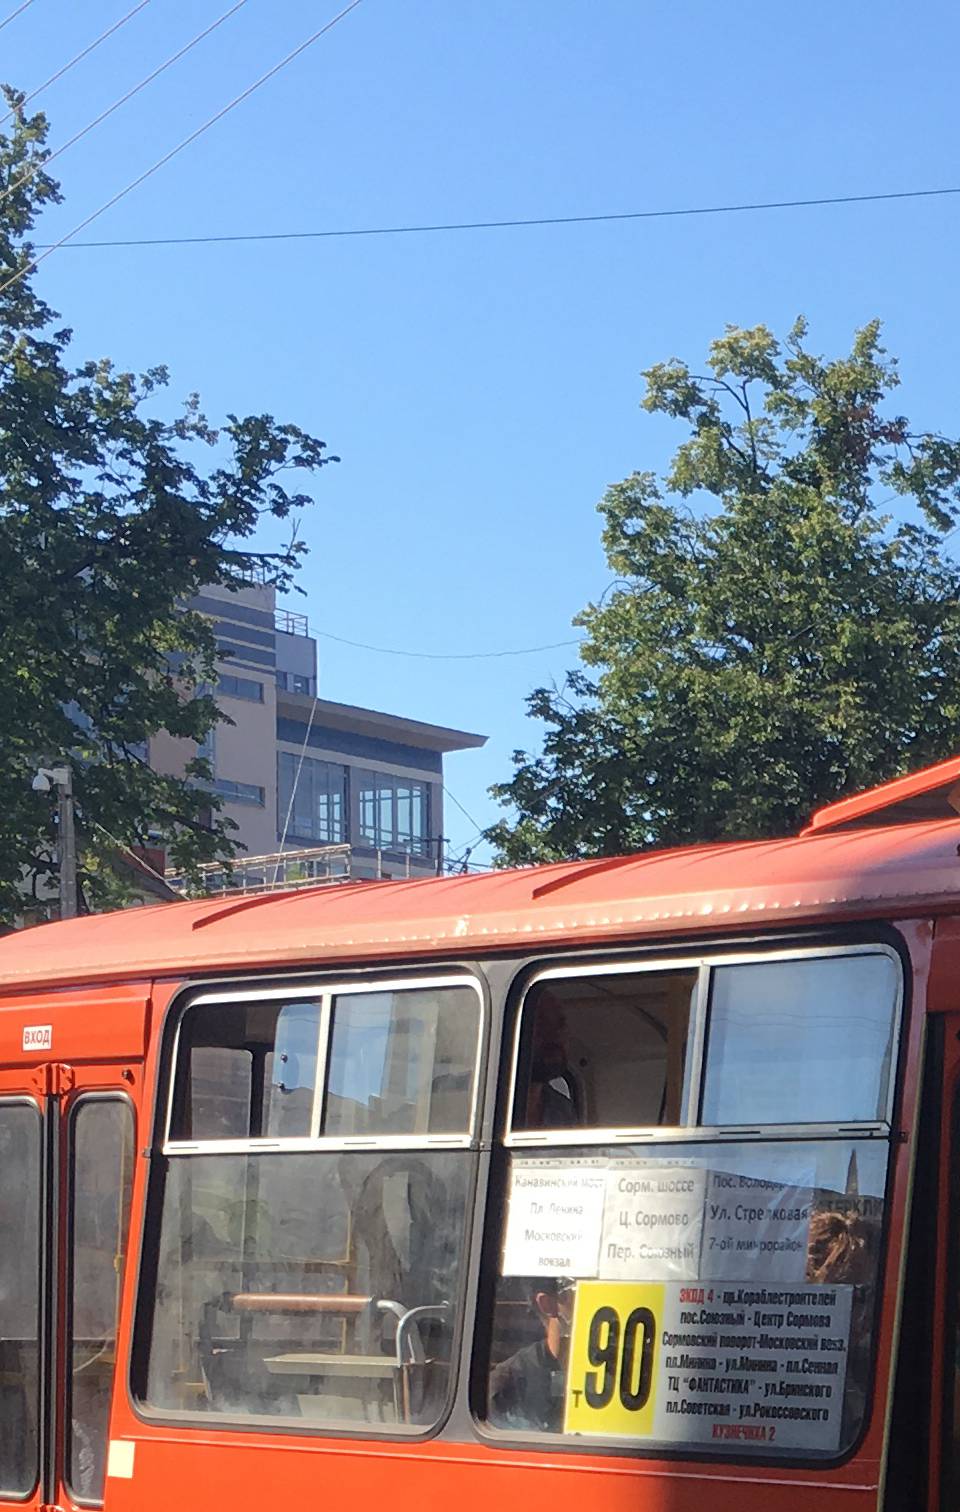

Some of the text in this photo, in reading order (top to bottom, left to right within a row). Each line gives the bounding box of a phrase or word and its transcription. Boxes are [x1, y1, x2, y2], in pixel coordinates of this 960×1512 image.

[25, 1030, 50, 1045] ВХОД
[618, 1178, 695, 1196] Сорм. шоссе
[713, 1175, 736, 1188] Пос.
[619, 1211, 689, 1229] Ц. Сормово
[710, 1205, 731, 1220] Ул.
[735, 1204, 809, 1224] Стрековая
[607, 1243, 635, 1262] Пер.
[538, 1257, 571, 1268] вокзал
[707, 1289, 715, 1303] 4
[754, 1311, 785, 1328] Центр
[662, 1331, 718, 1348] Сормовский
[585, 1306, 656, 1411] 90
[668, 1376, 681, 1392] ТЦ
[768, 1426, 776, 1441] 2
